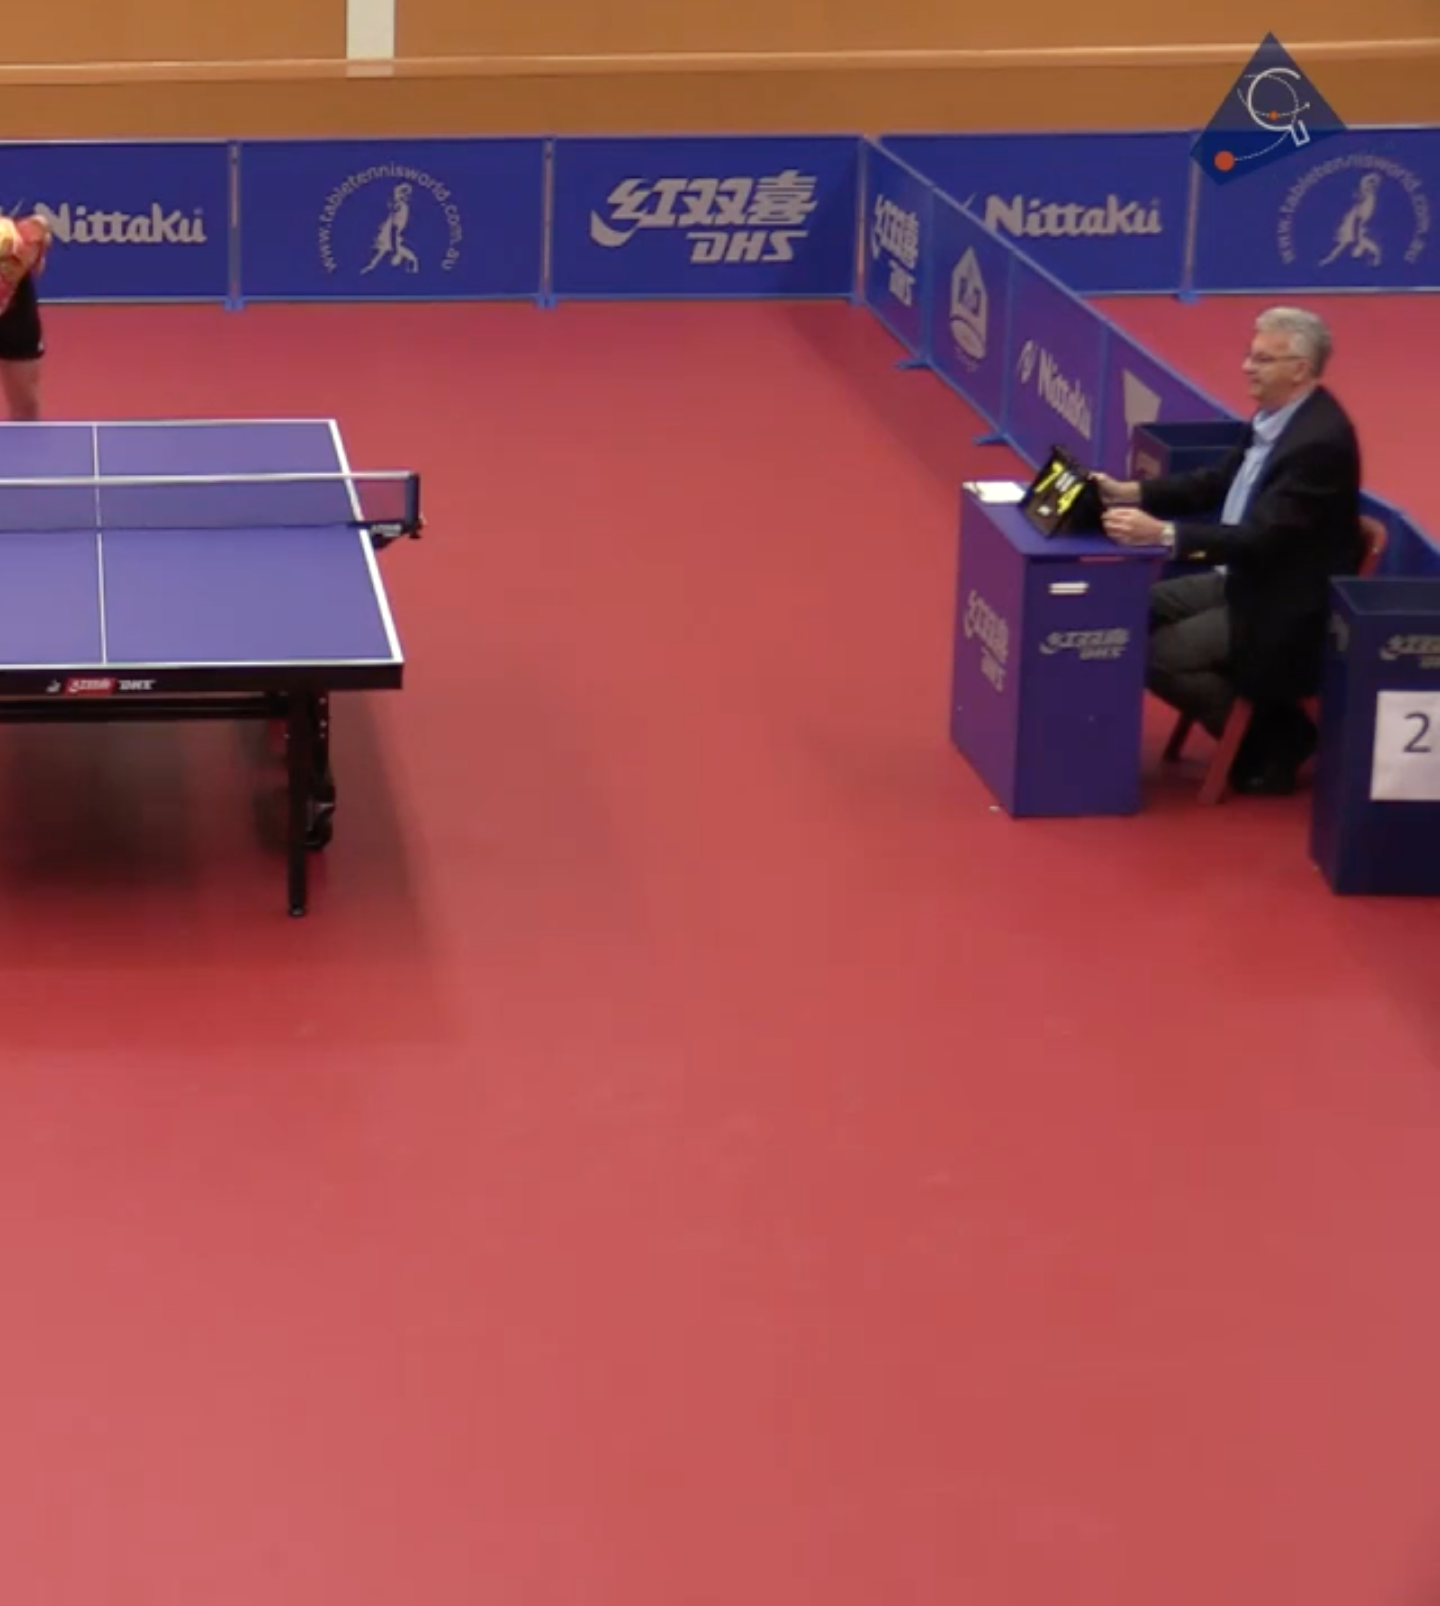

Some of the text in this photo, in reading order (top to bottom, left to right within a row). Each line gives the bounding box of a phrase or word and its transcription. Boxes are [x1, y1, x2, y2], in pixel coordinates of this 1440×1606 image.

[606, 169, 818, 229] 红双喜
[985, 193, 1162, 237] Nittaku
[33, 201, 207, 243] Nittaku
[686, 230, 809, 263] DHS
[1403, 711, 1432, 754] 2
